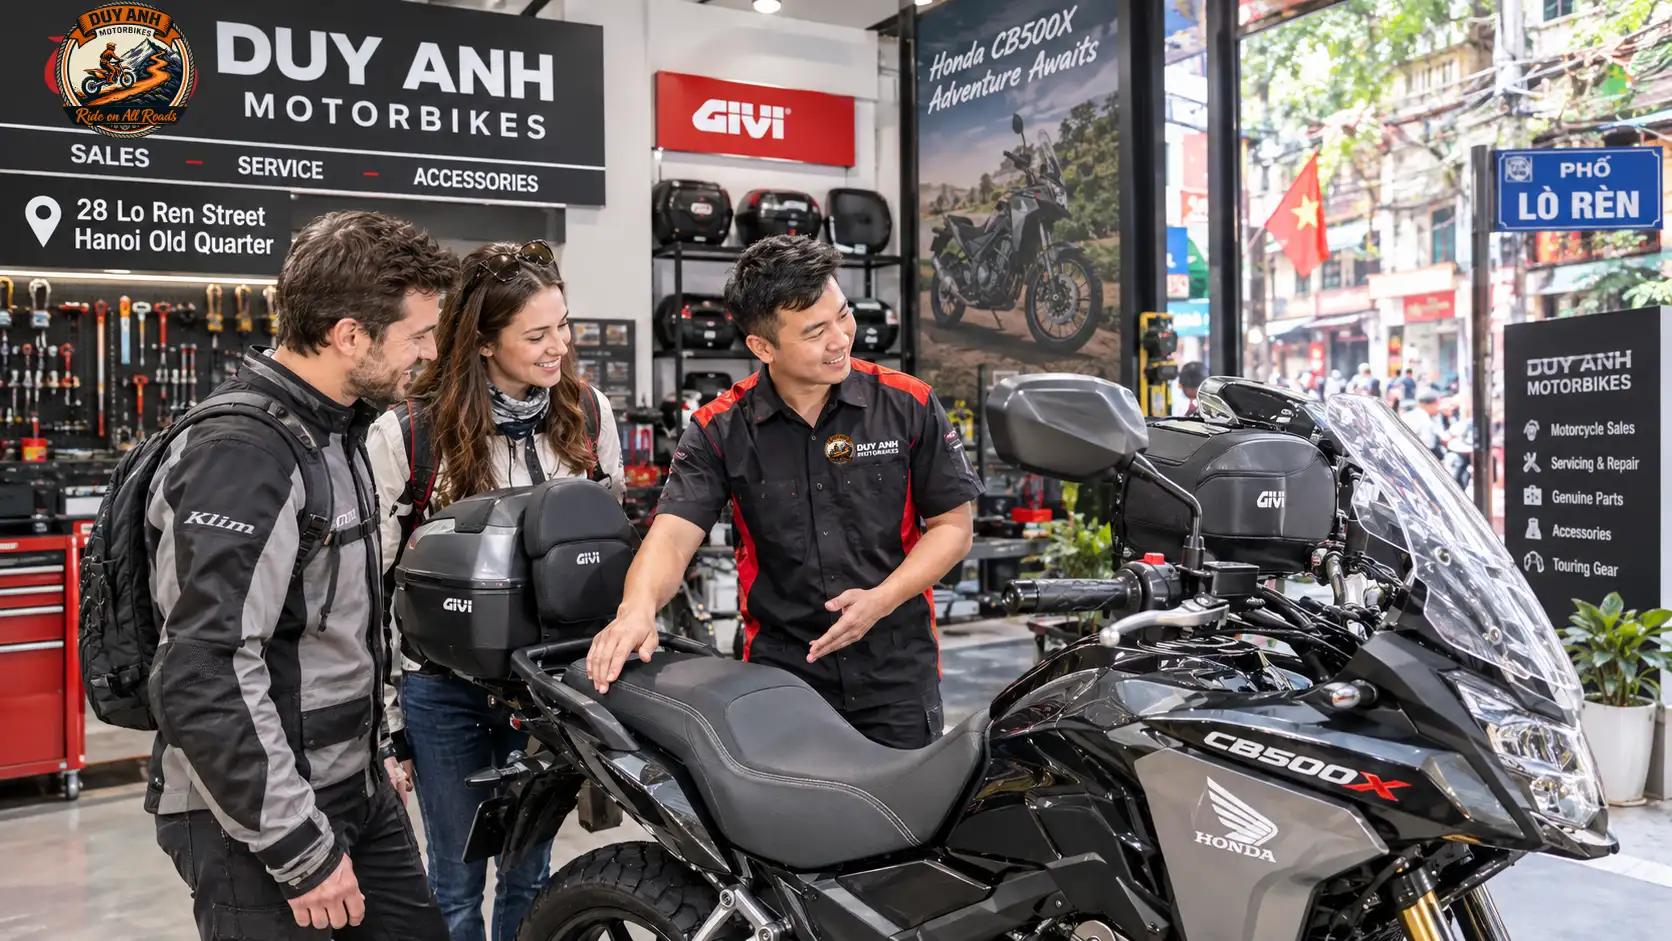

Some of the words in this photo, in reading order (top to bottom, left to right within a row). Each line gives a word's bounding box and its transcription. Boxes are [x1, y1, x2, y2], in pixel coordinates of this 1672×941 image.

[929, 40, 986, 82] Honda
[991, 5, 1078, 60] CB500X
[216, 20, 383, 86] DUY
[402, 41, 554, 102] ANH
[927, 67, 1022, 115] Adventure
[1028, 35, 1100, 83] Awaits
[244, 92, 547, 140] MOTORBIKES
[70, 143, 150, 168] SALES
[237, 155, 324, 180] SERVICE
[1560, 155, 1612, 178] PHỐ
[413, 167, 540, 193] ACCESSORIES
[77, 198, 108, 221] 28
[117, 199, 145, 223] Lo
[152, 201, 194, 224] Ren
[202, 204, 266, 227] Street
[1518, 185, 1559, 220] LÒ
[1571, 184, 1640, 219] RÈN
[75, 227, 141, 251] Hanoi
[149, 229, 186, 253] Old
[194, 231, 274, 256] Quarter
[1526, 356, 1573, 377] DUY
[1580, 350, 1632, 372] ANH
[1526, 374, 1632, 396] MOTORBIKES
[1550, 422, 1605, 438] Motorcycle
[1606, 421, 1636, 435] Sales
[856, 443, 877, 452] DUY
[878, 440, 899, 450] ANH
[1550, 456, 1595, 472] Servicing
[1596, 456, 1605, 470] &
[1607, 456, 1640, 472] Repair
[1256, 491, 1286, 509] GIVI
[1551, 490, 1594, 505] Genuine
[1595, 491, 1624, 506] Parts
[183, 510, 255, 535] Klim
[1552, 523, 1612, 541] Accessories
[576, 551, 600, 565] GIVI
[1552, 557, 1591, 577] Touring
[1593, 561, 1619, 577] Gear
[442, 597, 473, 613] GIVI
[1203, 731, 1412, 802] CB500X
[1194, 831, 1277, 864] HONDA
